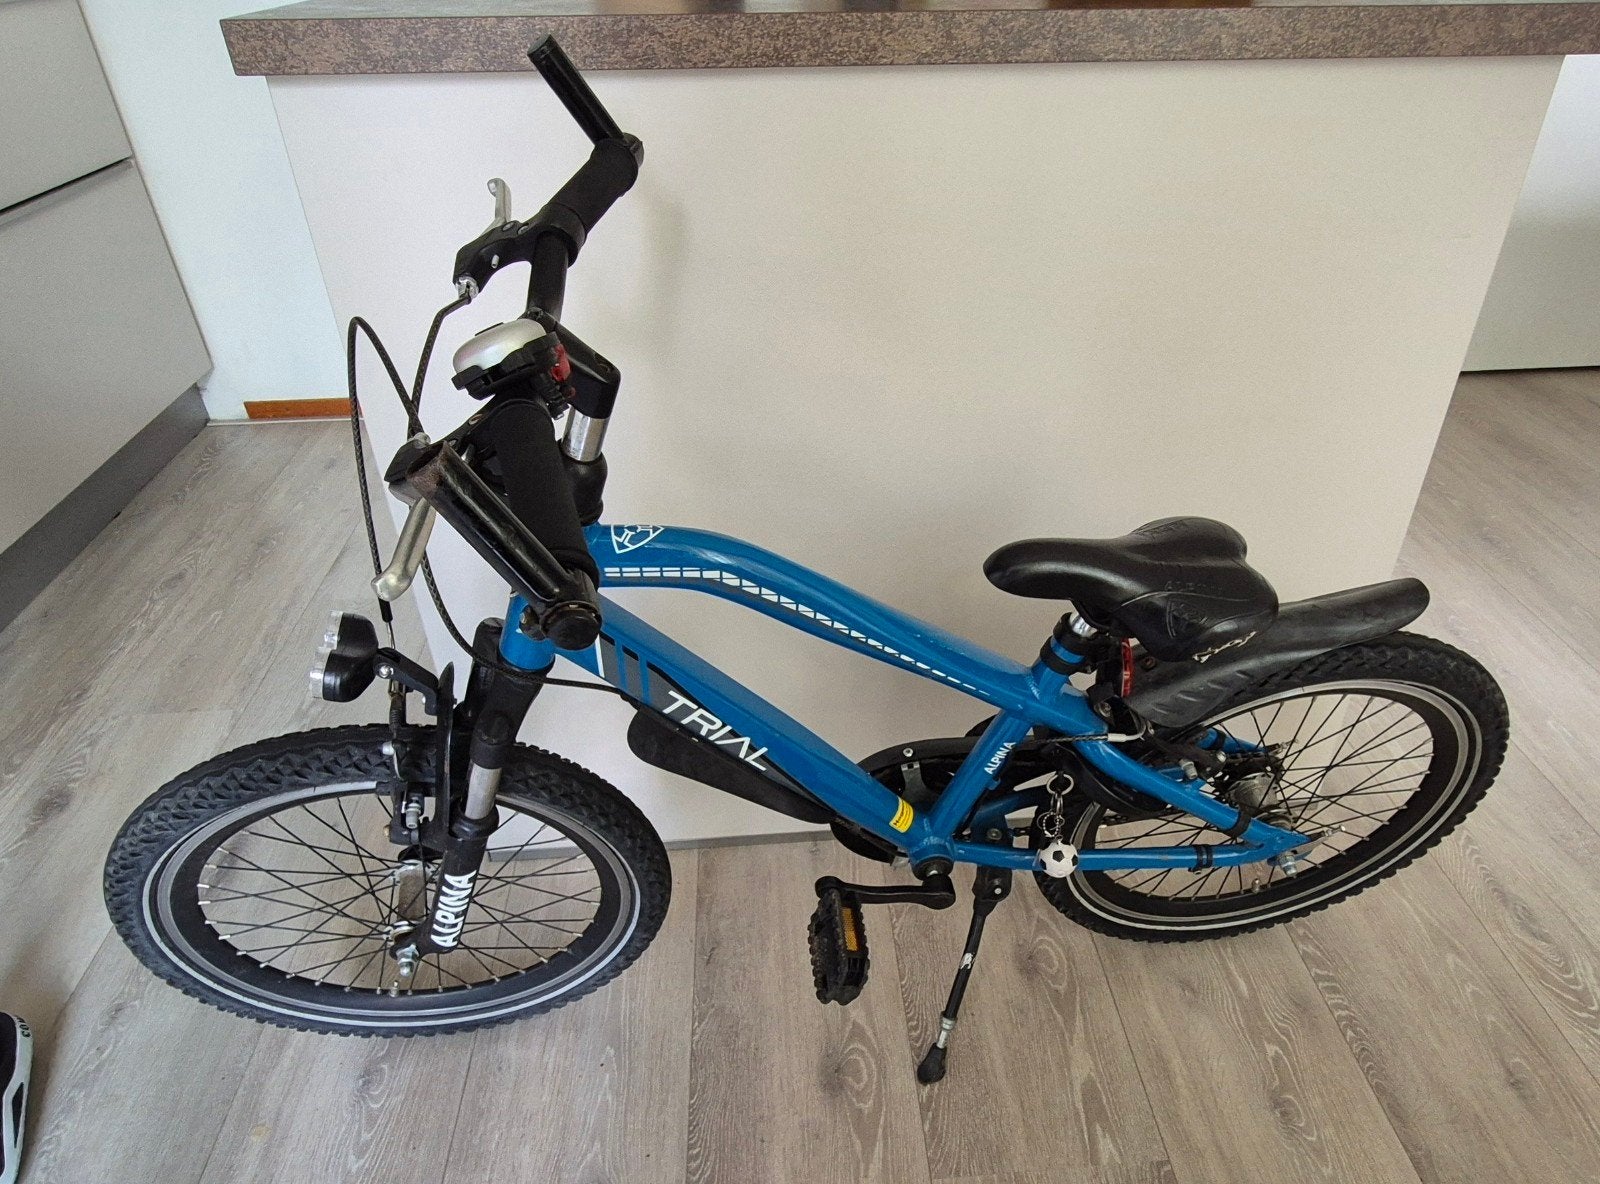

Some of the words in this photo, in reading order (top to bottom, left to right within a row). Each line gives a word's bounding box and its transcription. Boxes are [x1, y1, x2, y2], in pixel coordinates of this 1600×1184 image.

[662, 690, 768, 772] TRIAL
[984, 742, 1016, 774] ALPINA
[430, 870, 477, 947] ALPINA
